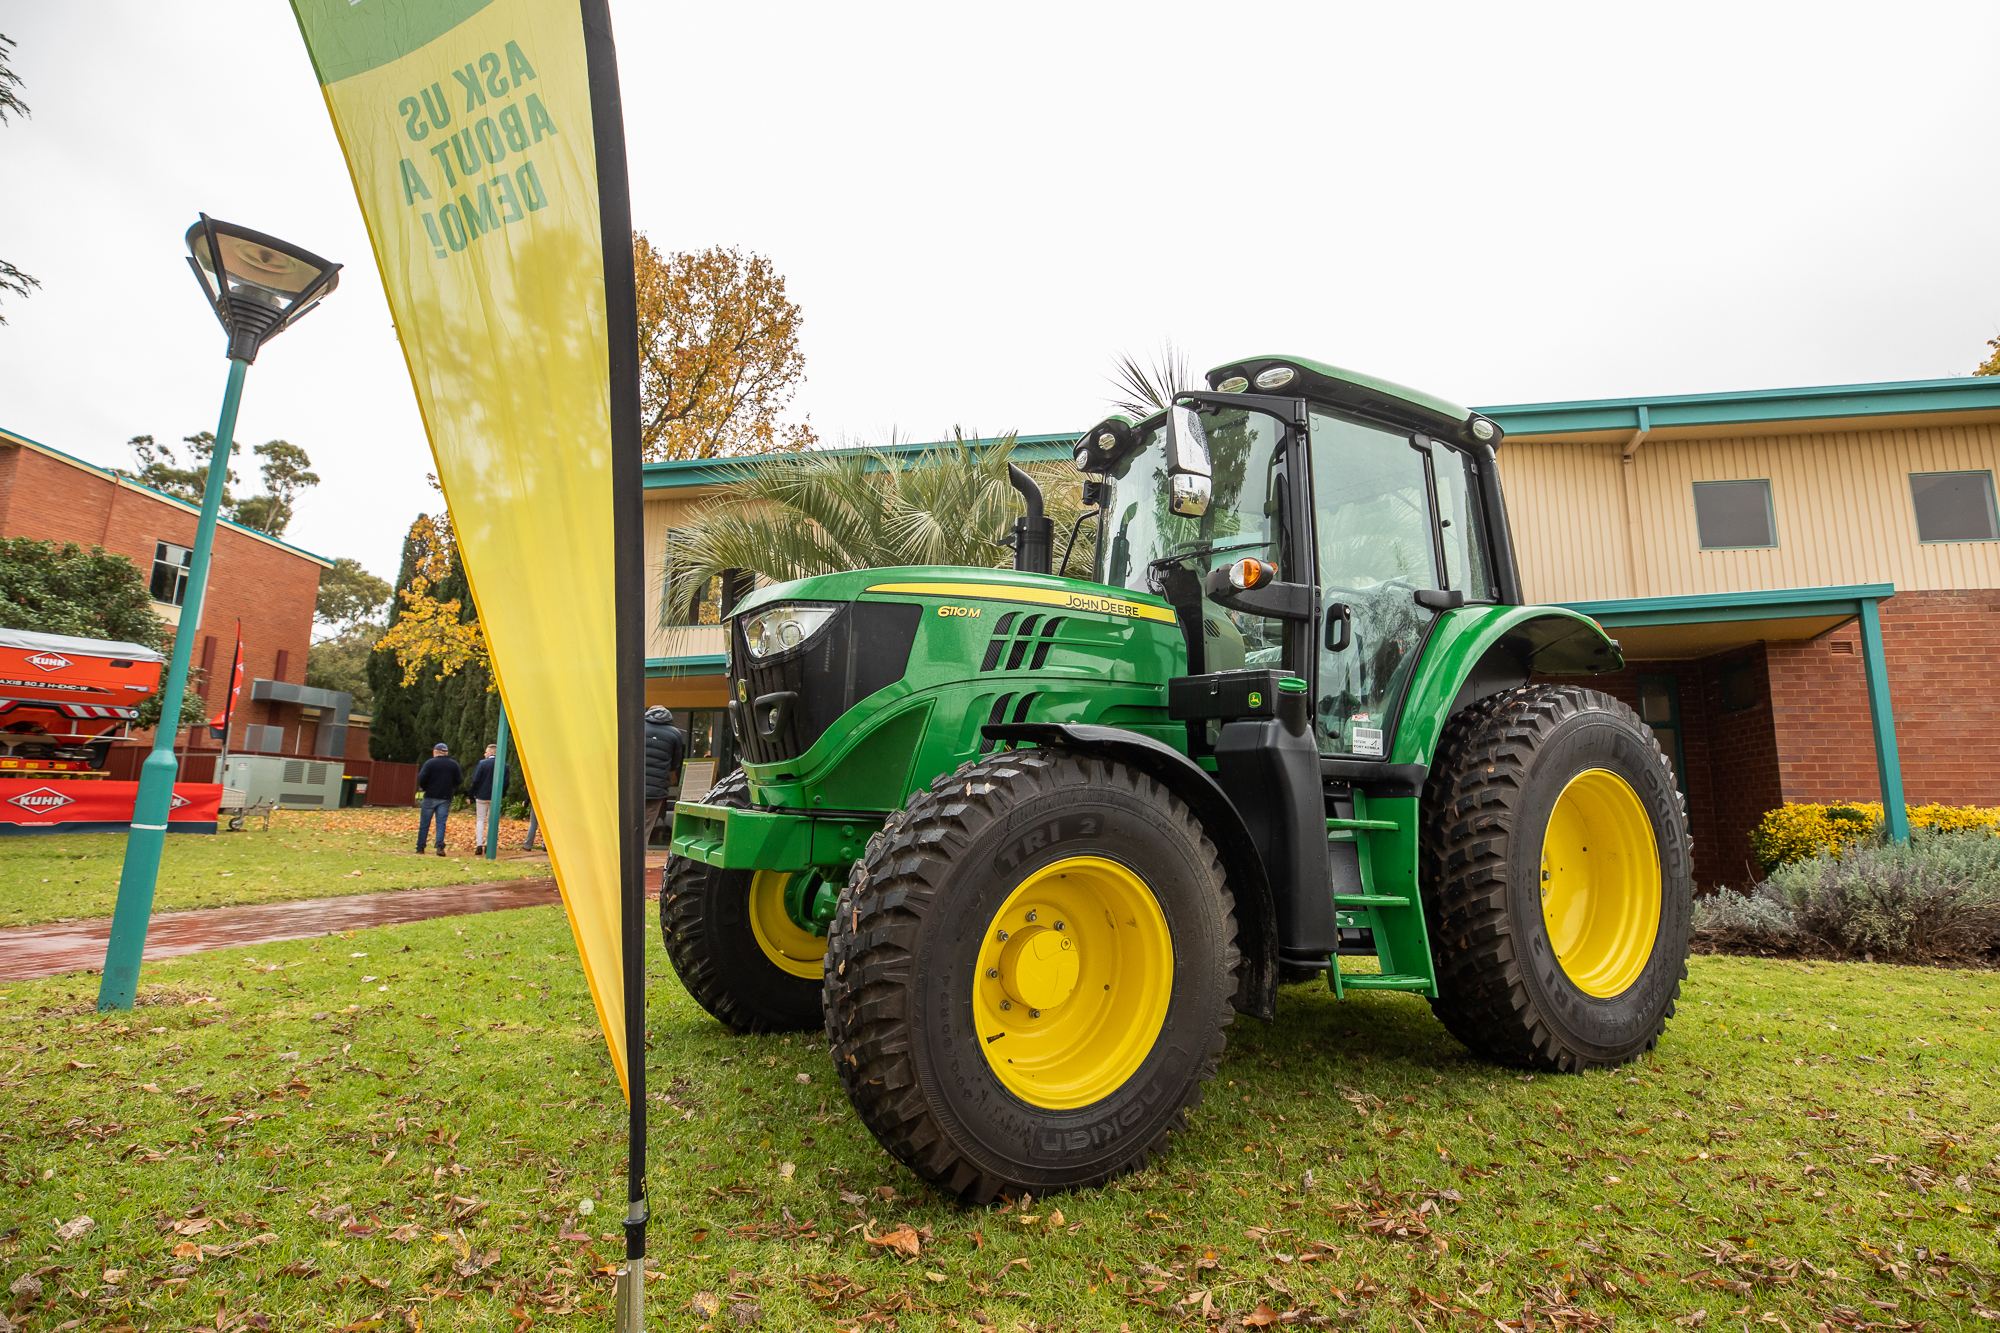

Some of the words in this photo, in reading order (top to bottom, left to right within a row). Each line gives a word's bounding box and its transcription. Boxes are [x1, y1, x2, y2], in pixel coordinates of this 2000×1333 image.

[32, 656, 67, 667] KUHN
[19, 796, 65, 806] KUHN
[1000, 821, 1060, 868] TRI
[1078, 817, 1097, 834] 2
[1041, 1080, 1163, 1151] nokian
